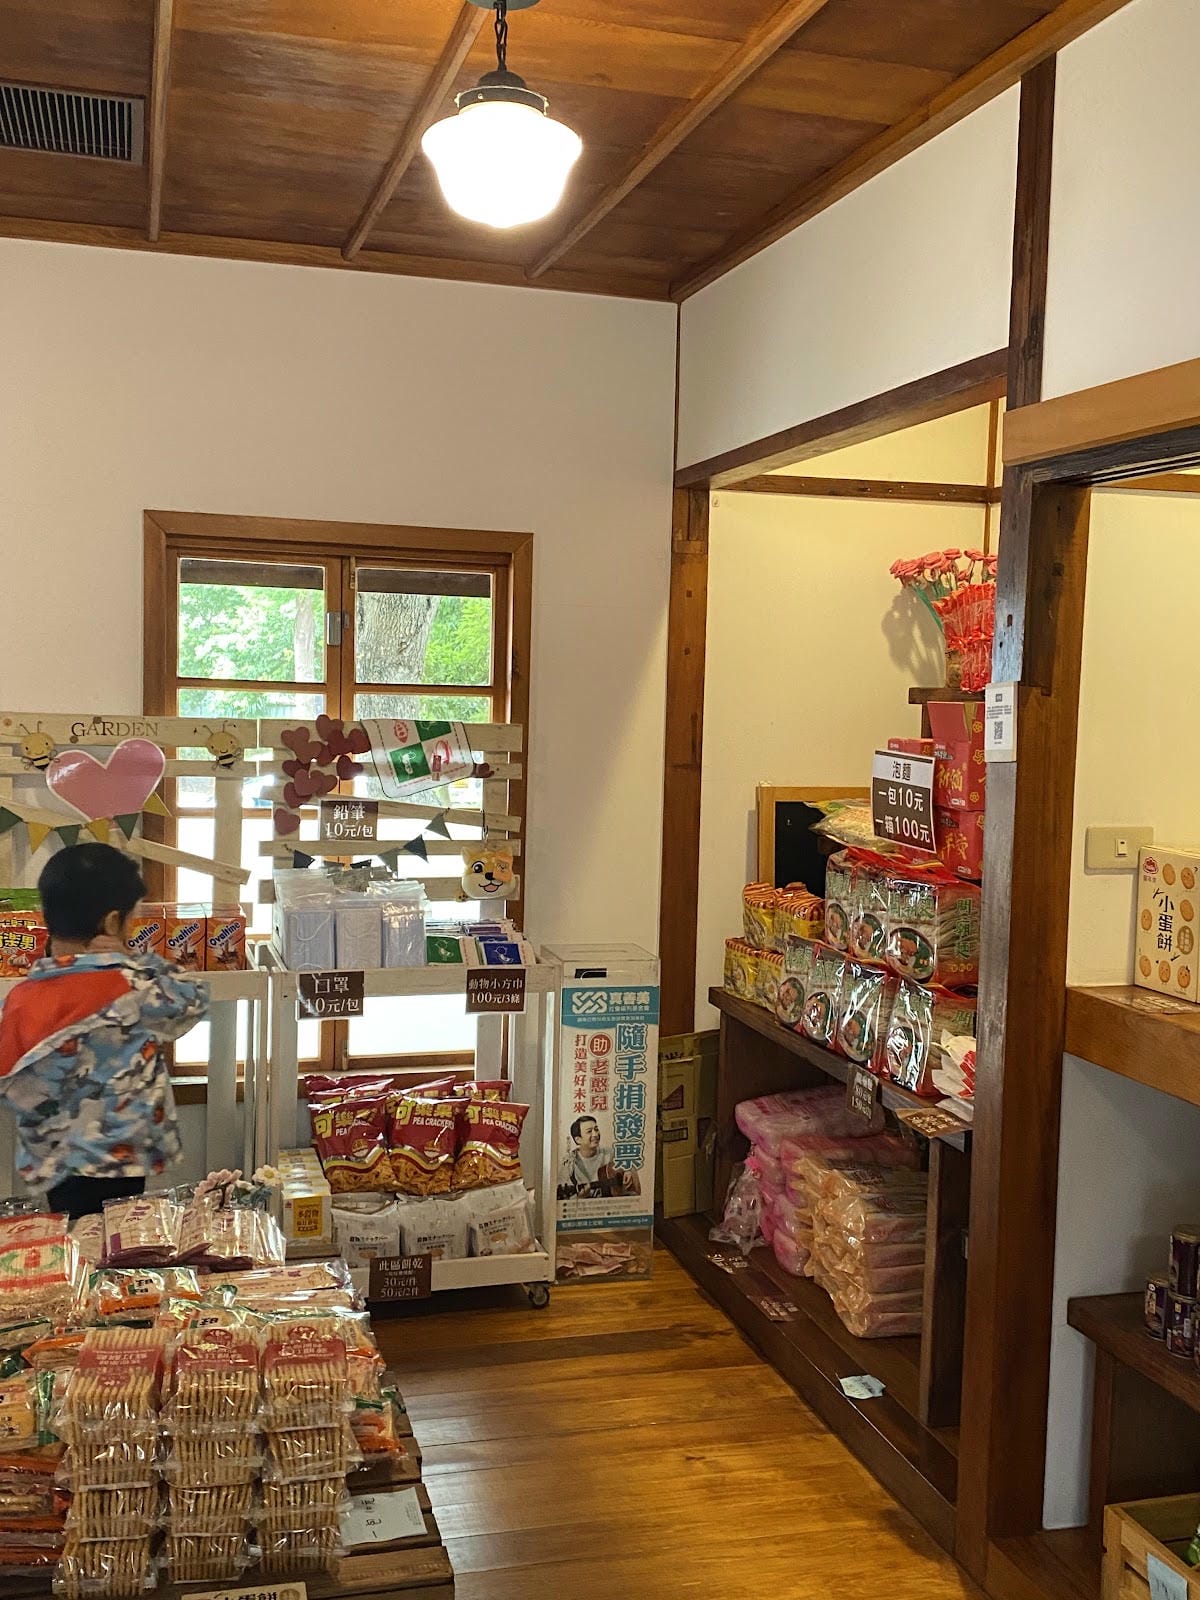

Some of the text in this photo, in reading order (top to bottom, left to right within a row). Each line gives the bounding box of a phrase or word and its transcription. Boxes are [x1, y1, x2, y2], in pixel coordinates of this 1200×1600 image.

[71, 721, 159, 737] GARDEN
[878, 786, 924, 812] 一包10元
[333, 804, 366, 821] 鉛筆
[324, 822, 374, 838] 10元/包
[875, 814, 931, 843] 一箱100元
[1156, 895, 1175, 953] 小蛋餅
[127, 922, 160, 948] Ovaltine
[167, 922, 200, 948] Ovaltine
[209, 921, 241, 947] Ovaltine
[314, 976, 350, 995] 口罩
[468, 977, 523, 990] 動物小方巾
[304, 997, 360, 1014] 10元/包
[572, 1034, 588, 1114] 打造美好未來
[613, 1022, 648, 1171] 隨手捐發票
[412, 1116, 455, 1130] PEA CRACKERS
[482, 1118, 494, 1126] PEA
[335, 1127, 347, 1137] PEA
